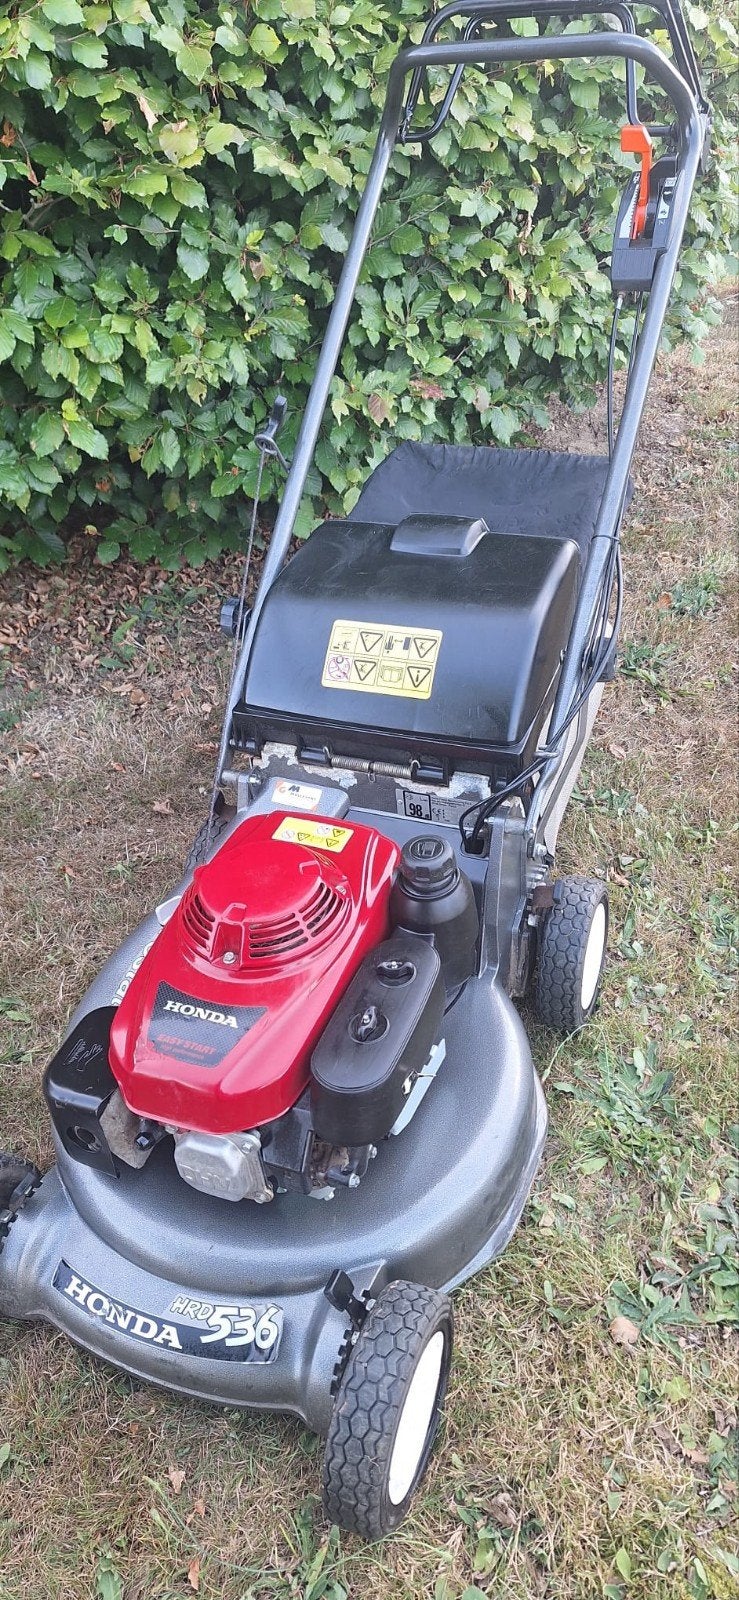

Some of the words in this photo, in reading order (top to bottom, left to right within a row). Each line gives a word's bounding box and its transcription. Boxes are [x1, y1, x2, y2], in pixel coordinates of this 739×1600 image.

[409, 803, 423, 817] 98
[163, 1000, 239, 1029] HONDA
[64, 1274, 182, 1350] HONDA
[169, 1296, 214, 1322] HRD
[200, 1304, 280, 1350] 536
